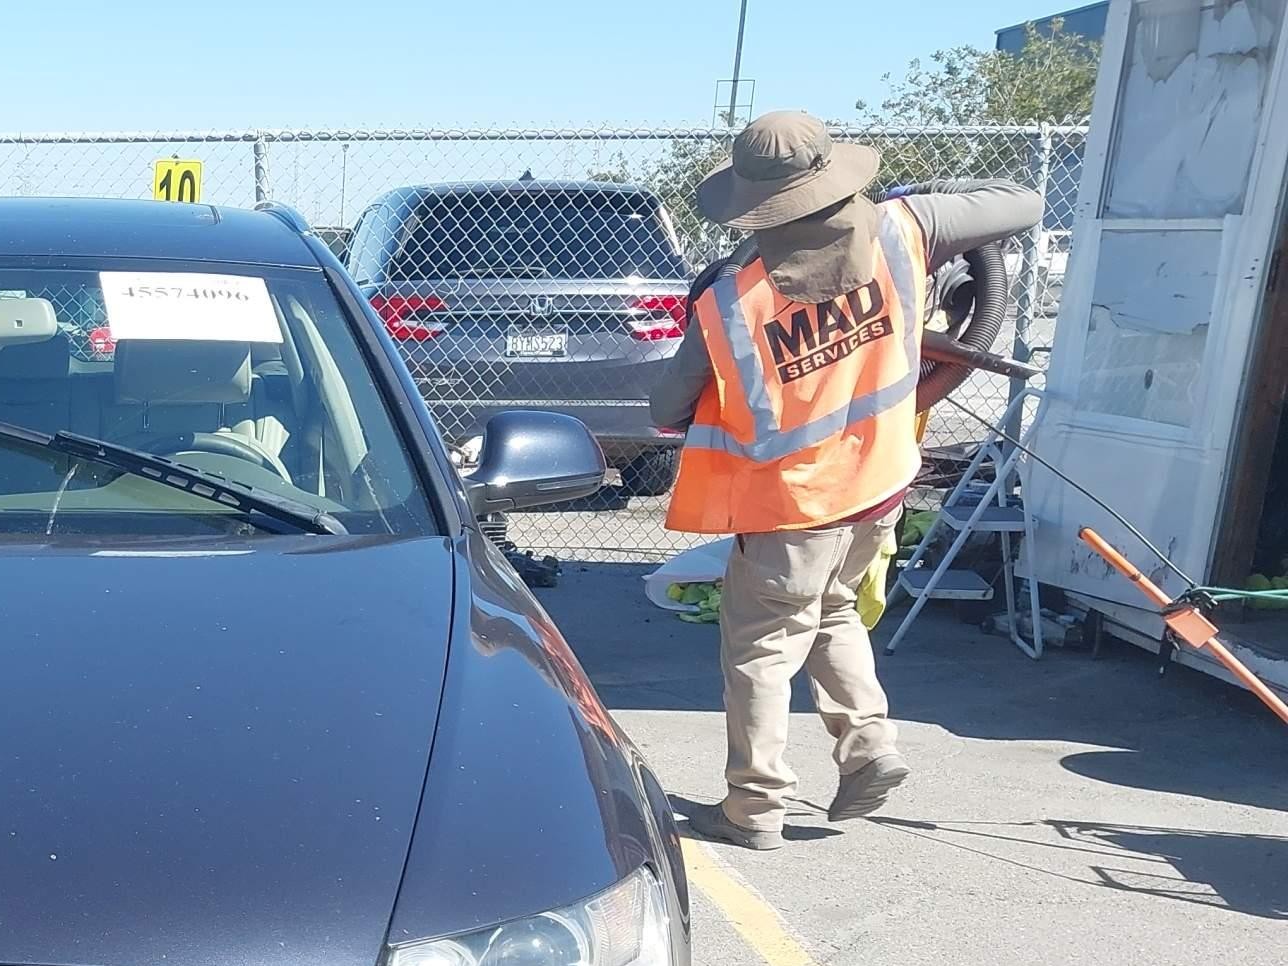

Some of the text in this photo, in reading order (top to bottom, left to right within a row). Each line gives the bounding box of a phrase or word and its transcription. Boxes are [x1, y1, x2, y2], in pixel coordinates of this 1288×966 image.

[159, 169, 196, 202] 10
[763, 278, 884, 365] MAD
[786, 321, 885, 378] SERVICES
